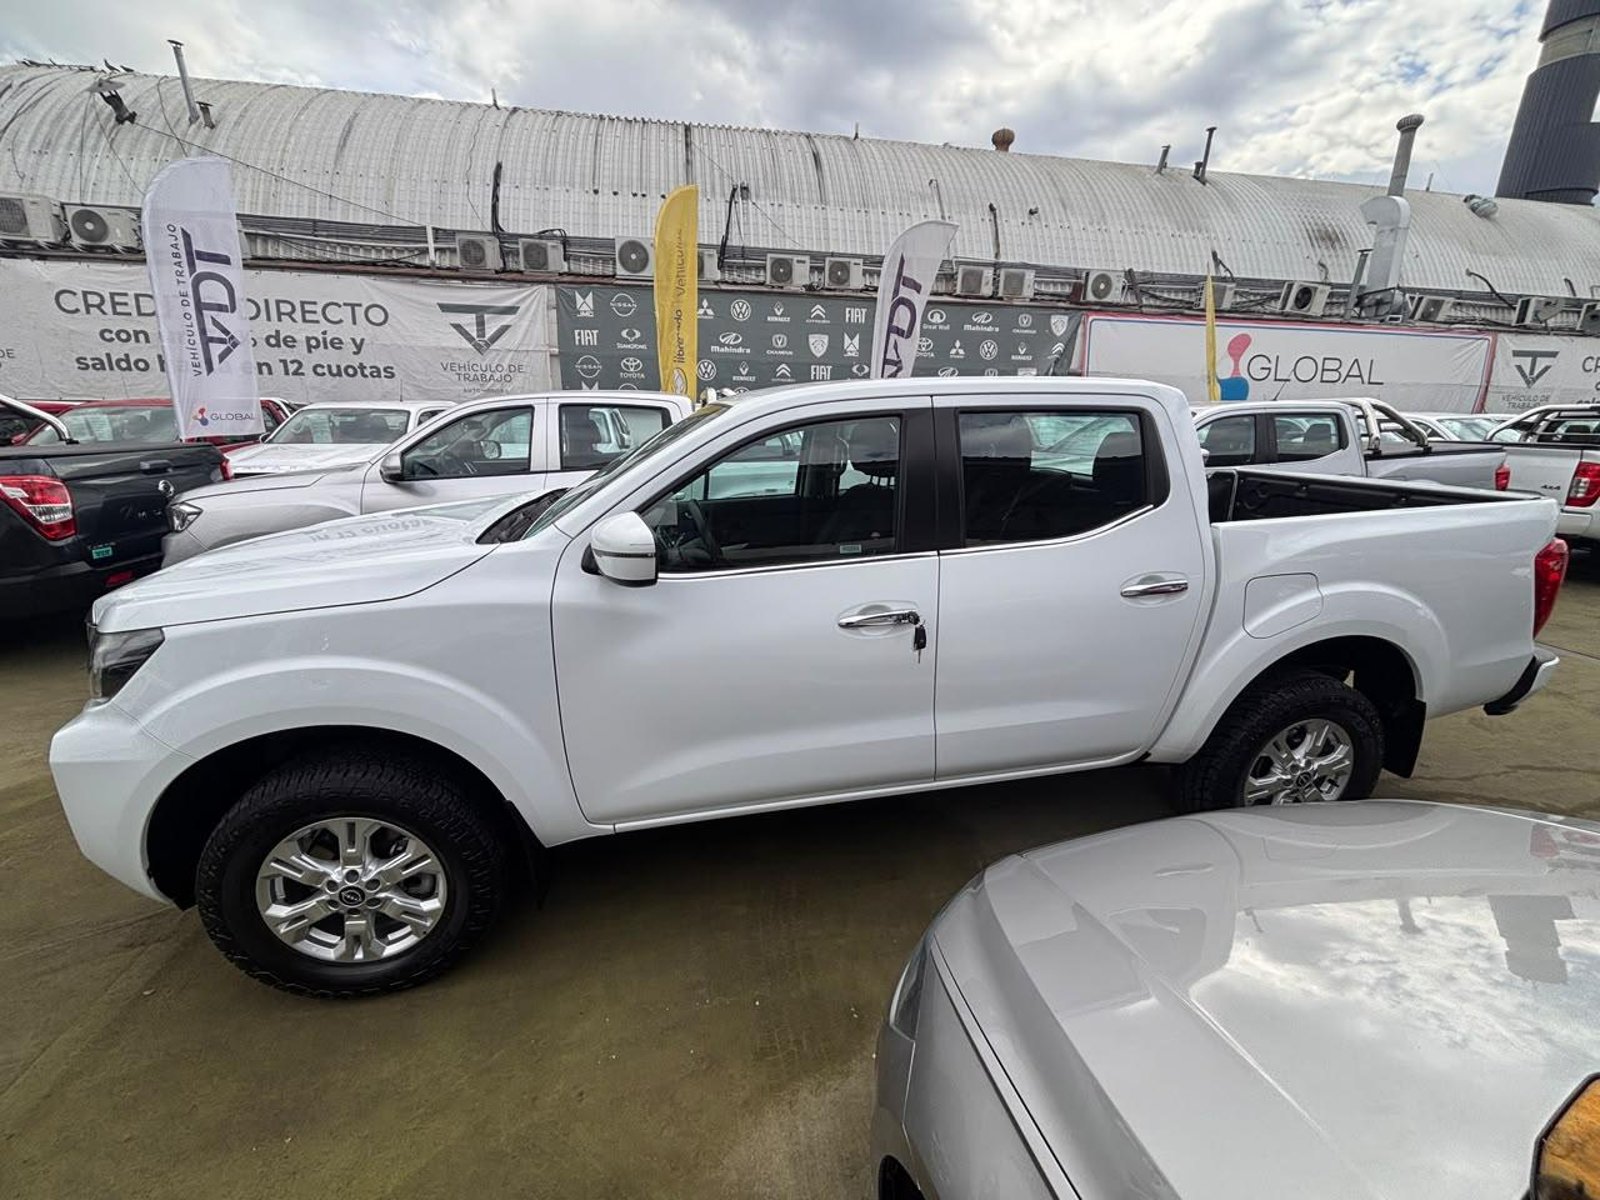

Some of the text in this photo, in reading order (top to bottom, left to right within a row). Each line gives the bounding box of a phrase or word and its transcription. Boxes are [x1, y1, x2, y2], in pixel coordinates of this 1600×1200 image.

[167, 223, 202, 377] VEHÍCULO DE TRABAJO
[845, 307, 868, 324] FIAT
[99, 327, 150, 344] con
[265, 329, 297, 349] de
[350, 336, 365, 356] y
[574, 329, 599, 346] FIAT
[76, 352, 150, 373] saldo
[257, 359, 396, 380] n 12 cuotas
[508, 364, 524, 373] DE
[1247, 353, 1385, 386] GLOBAL
[455, 373, 513, 383] TRABAJO
[810, 364, 833, 380] FIAT
[210, 411, 255, 422] GLOBAL
